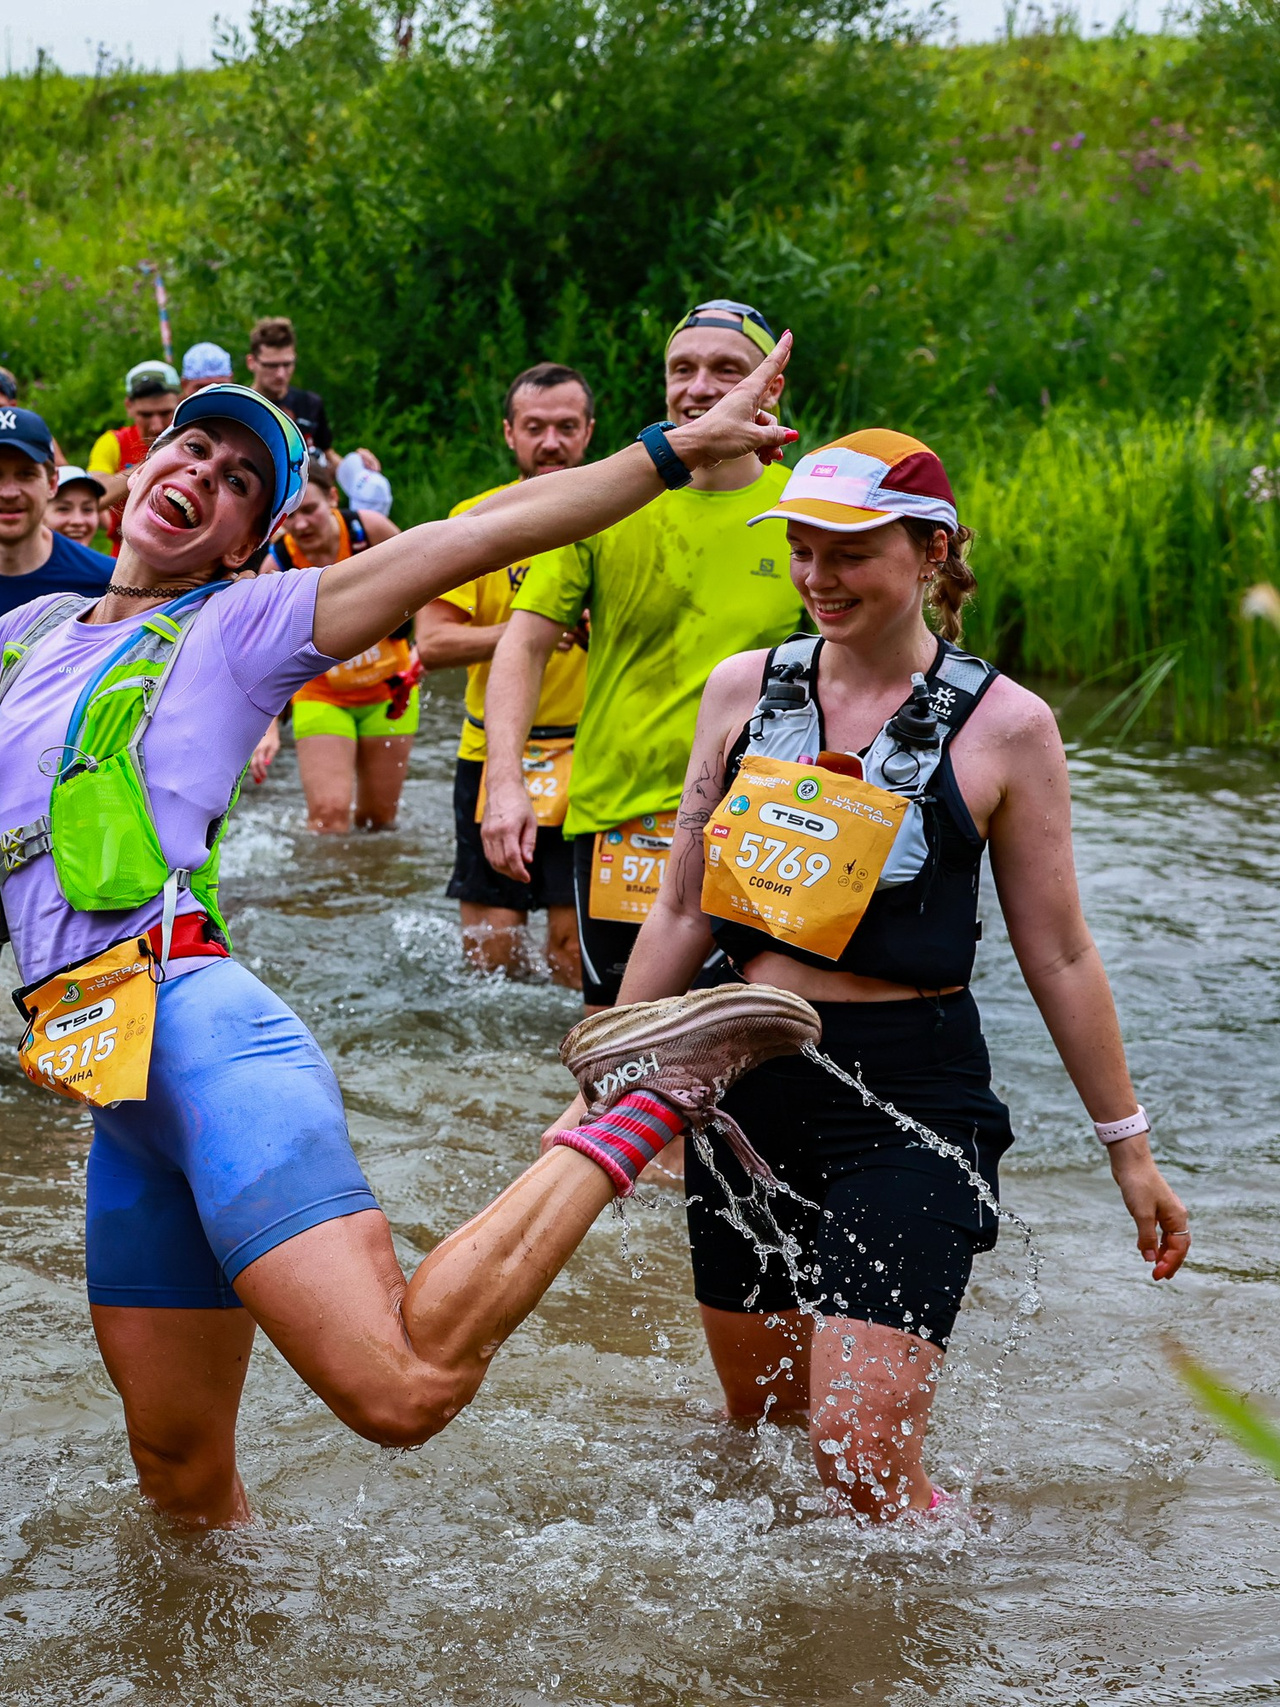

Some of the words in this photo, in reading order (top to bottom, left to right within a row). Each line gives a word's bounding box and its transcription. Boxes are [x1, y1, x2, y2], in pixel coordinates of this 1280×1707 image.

[928, 701, 952, 716] AILAS
[823, 797, 865, 817] TRAIL
[868, 813, 894, 828] 100
[836, 795, 884, 817] ULTRA
[771, 808, 824, 833] T50
[622, 855, 666, 884] 571
[734, 830, 832, 889] 5769
[626, 884, 660, 894] ВЛАДИ
[748, 876, 793, 897] СОФИЯ
[94, 962, 142, 984] ULTRA
[56, 1007, 103, 1032] T50
[62, 1069, 93, 1087] РИНА
[593, 1051, 660, 1097] HOKA
